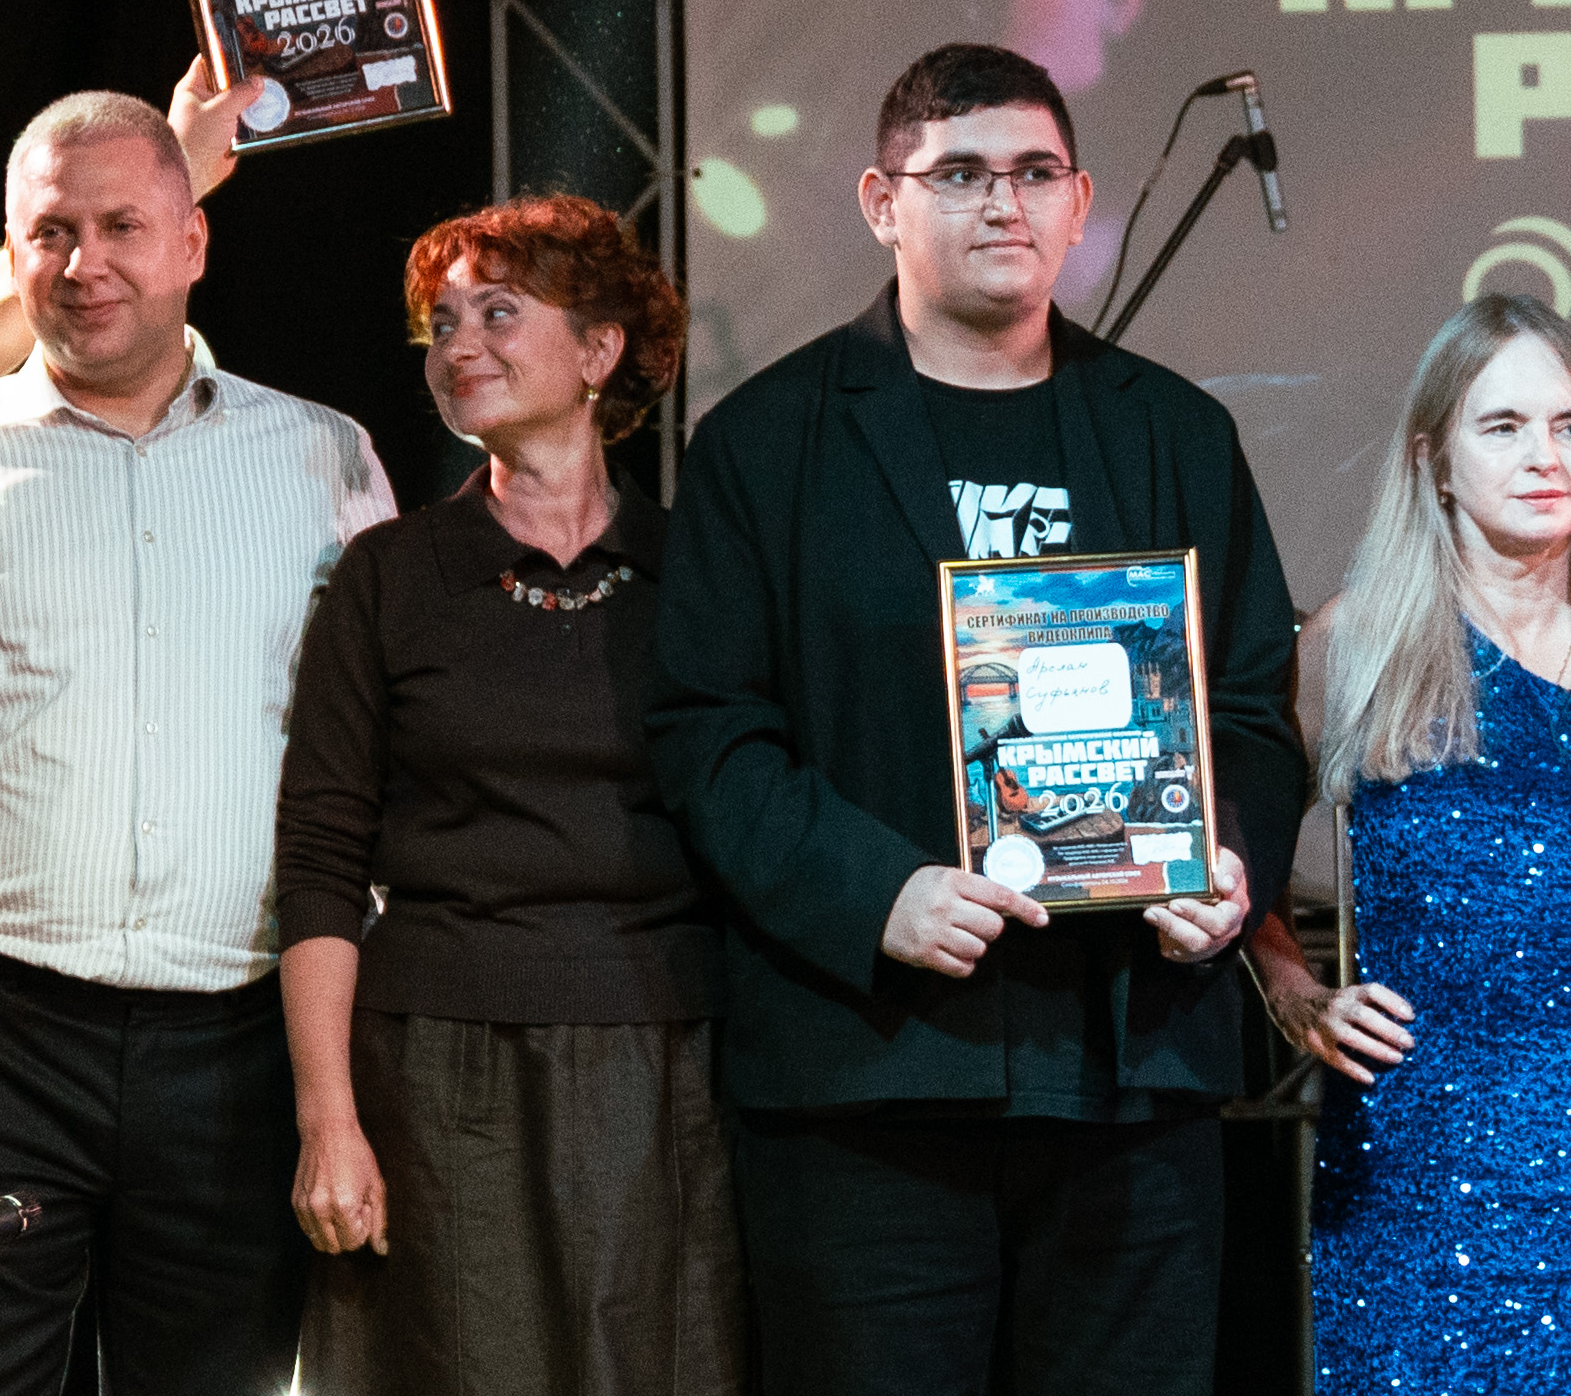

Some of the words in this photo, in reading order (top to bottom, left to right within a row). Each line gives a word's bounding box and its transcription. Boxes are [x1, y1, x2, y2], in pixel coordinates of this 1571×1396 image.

[276, 16, 357, 58] 2026
[967, 611, 1048, 629] СЕРТИФИКАТ
[1050, 610, 1068, 624] НА
[1069, 604, 1171, 622] ПРОИЗВОДСТВО
[1028, 626, 1113, 643] ВИДЕОКЛИПА
[997, 731, 1160, 767] КРЫМСКИЙ
[1028, 760, 1148, 787] РАССВЕТ
[1038, 782, 1129, 817] 2026
